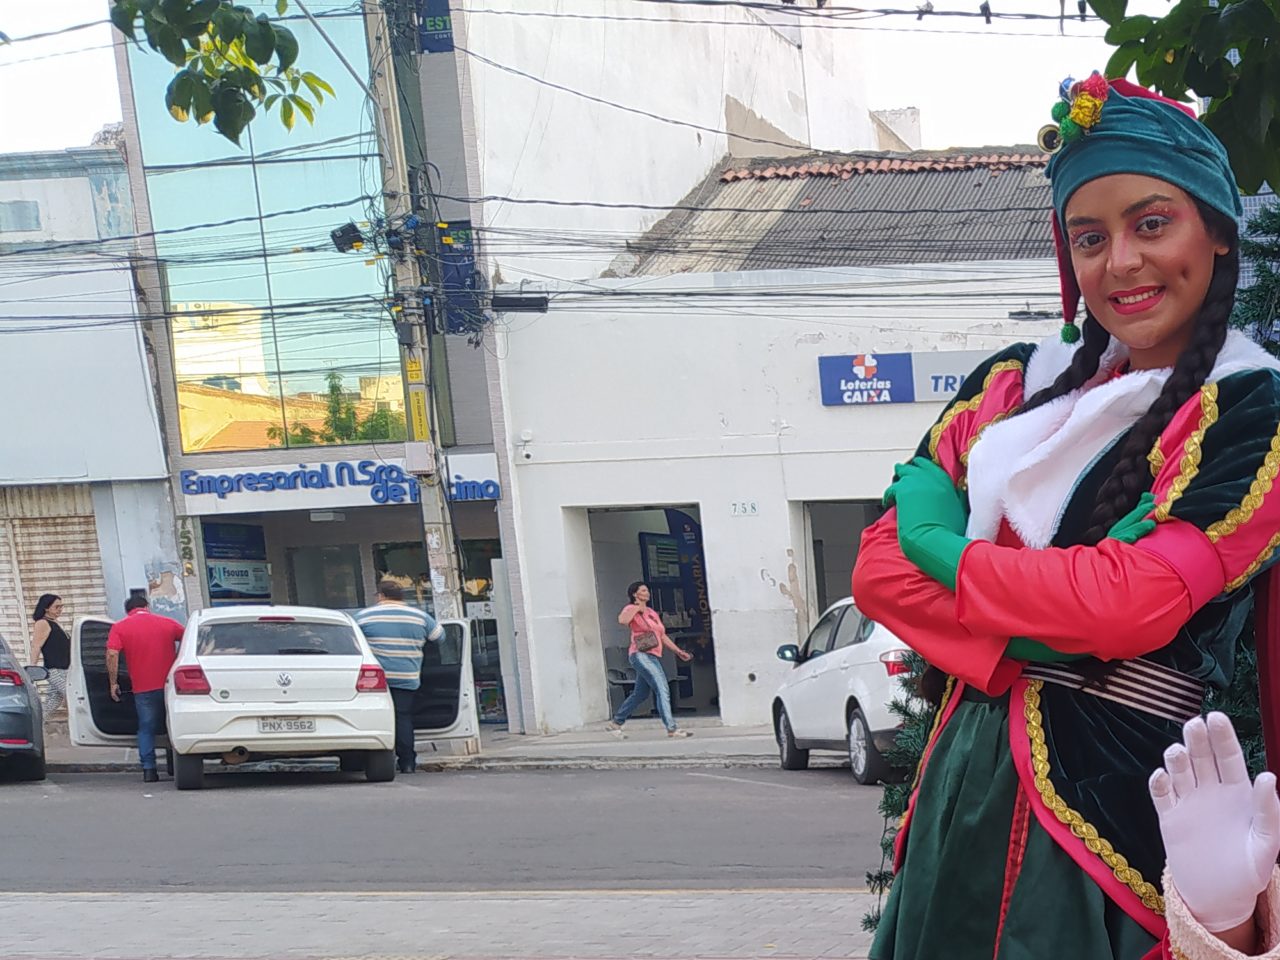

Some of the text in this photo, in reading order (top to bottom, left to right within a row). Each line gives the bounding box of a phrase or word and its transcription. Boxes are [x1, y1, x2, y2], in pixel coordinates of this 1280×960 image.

[840, 379, 891, 390] Loterias
[843, 390, 892, 403] CAIXA
[181, 463, 334, 499] Empresarial
[731, 502, 757, 513] 758
